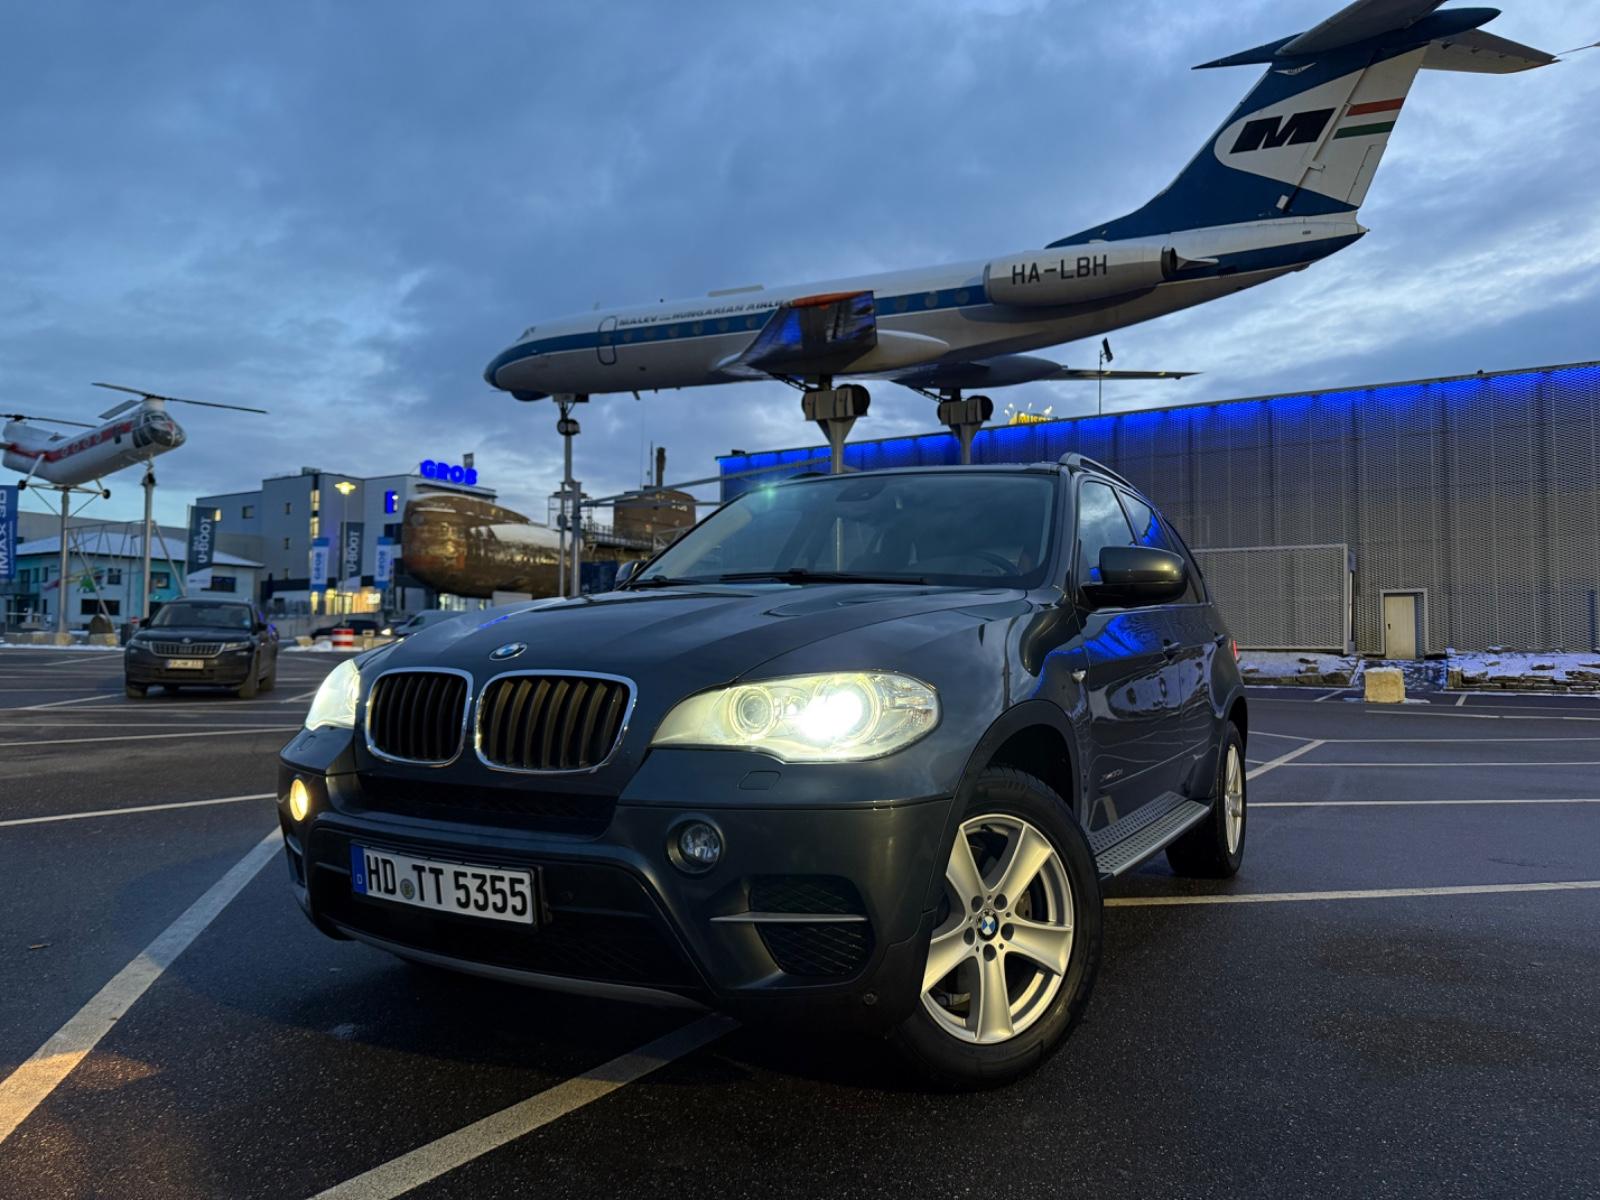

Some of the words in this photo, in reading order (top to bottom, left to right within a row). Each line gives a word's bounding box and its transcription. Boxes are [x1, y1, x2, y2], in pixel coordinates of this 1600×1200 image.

[1012, 254, 1108, 285] HA-LBH
[672, 303, 744, 320] HUNGARIAN
[420, 459, 478, 486] GROB
[0, 523, 9, 575] IMAX
[197, 516, 211, 563] U-BOOT
[347, 530, 360, 573] U-BOOT
[356, 873, 363, 885] D
[366, 854, 397, 895] HD
[412, 864, 444, 905] TT
[453, 870, 528, 917] 5355
